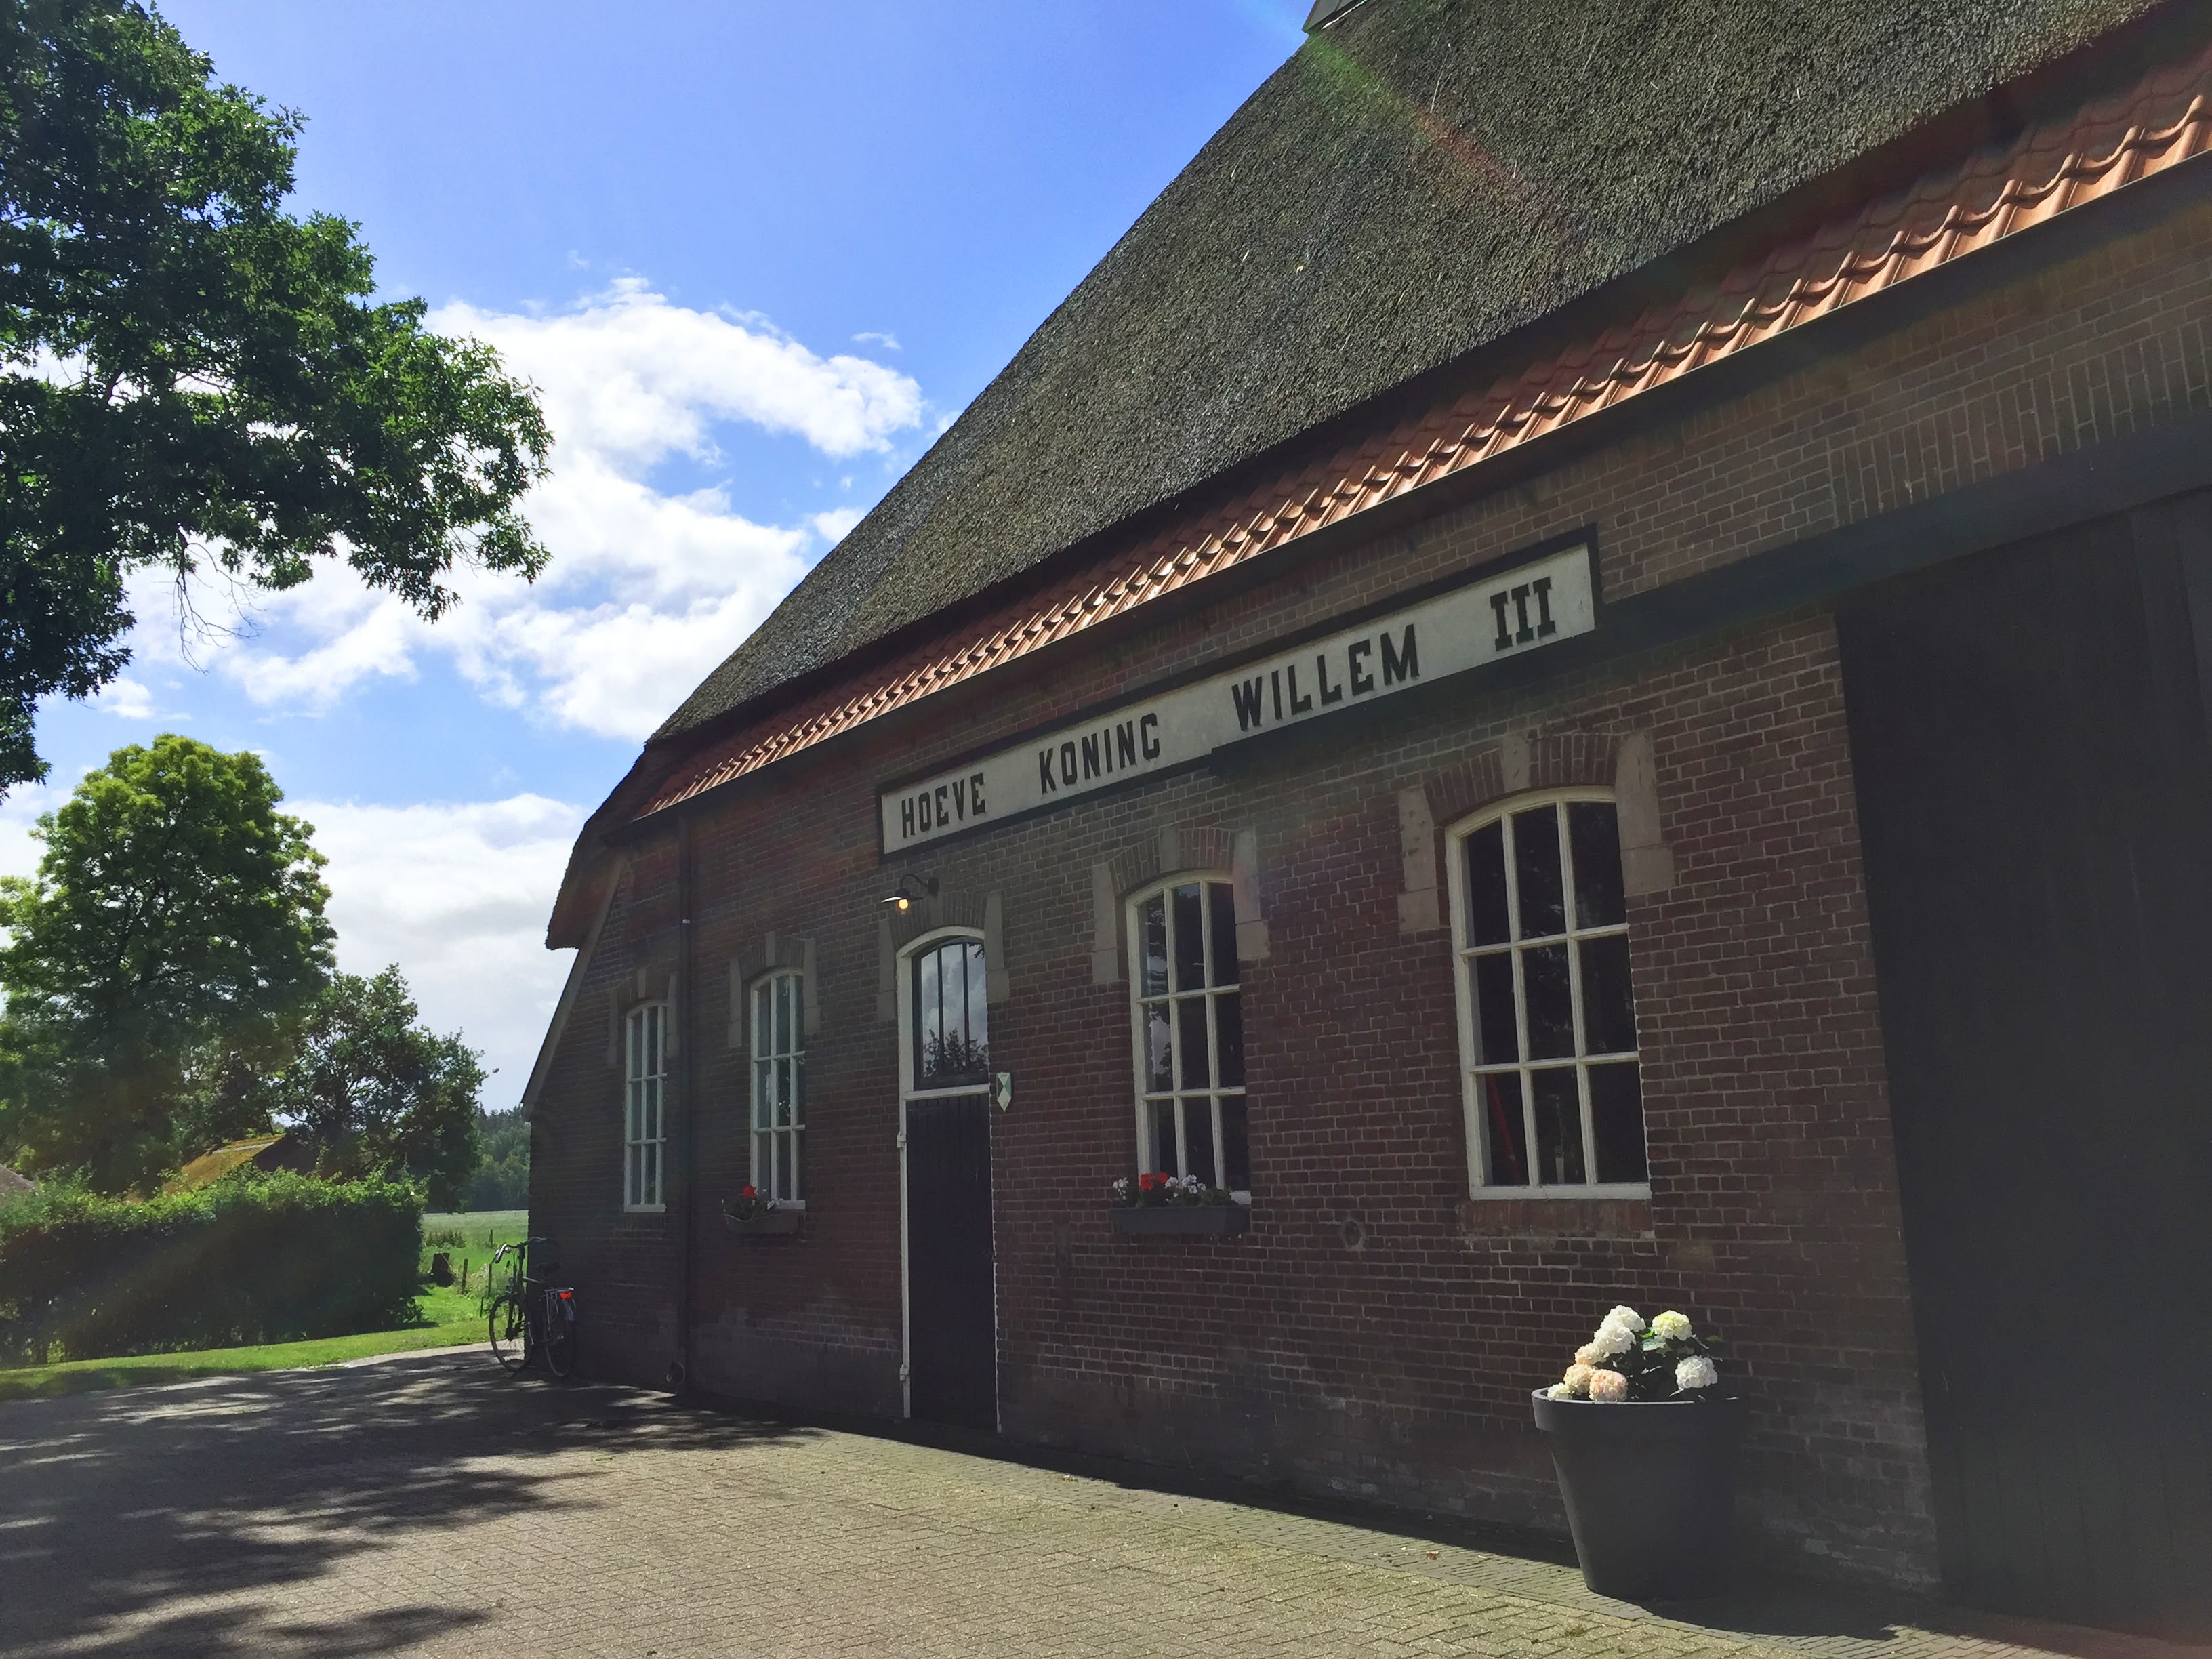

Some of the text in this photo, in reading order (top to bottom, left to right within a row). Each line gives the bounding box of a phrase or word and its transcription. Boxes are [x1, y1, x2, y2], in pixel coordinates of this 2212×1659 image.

[901, 773, 986, 838] HOEVE
[1231, 624, 1420, 731] WILLEM
[1490, 577, 1556, 651] III
